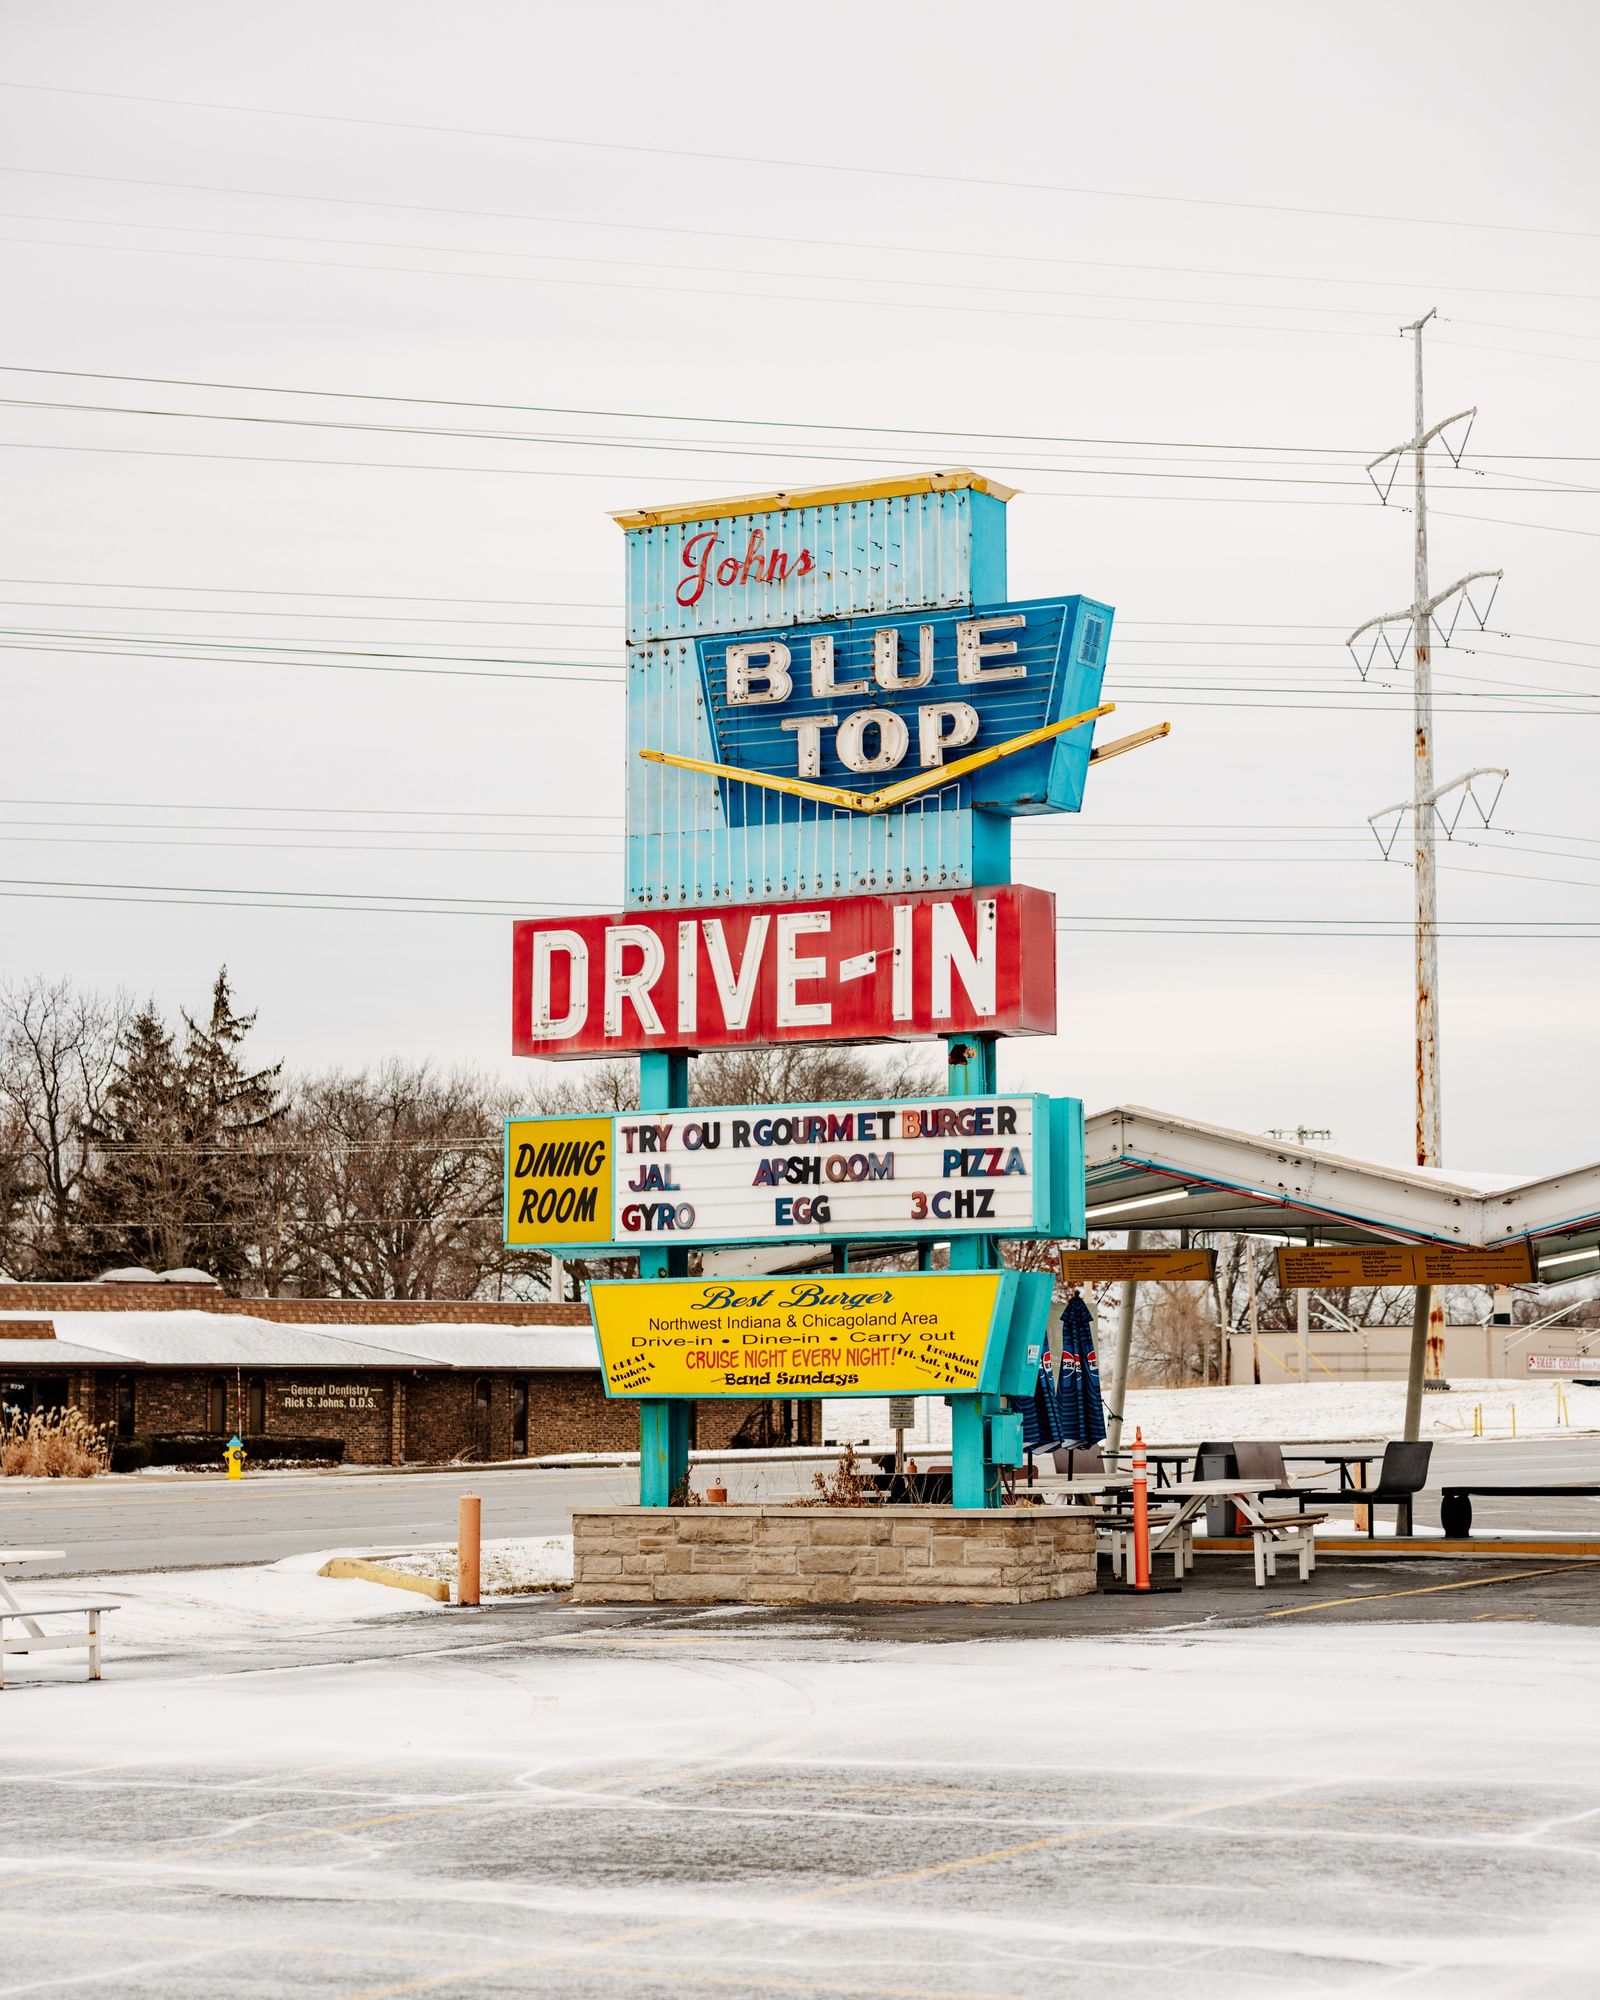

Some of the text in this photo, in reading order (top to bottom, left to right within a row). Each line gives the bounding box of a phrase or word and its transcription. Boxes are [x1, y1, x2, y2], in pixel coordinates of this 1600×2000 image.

[676, 529, 816, 607] Johns
[726, 614, 1027, 706] BLUE
[781, 701, 980, 778] TOP
[532, 899, 998, 1041] DRIVE-IN
[621, 1124, 673, 1154] TRY
[902, 1106, 1017, 1139] BURGER
[514, 1140, 606, 1178] DINING
[628, 1163, 681, 1192] JAL
[943, 1147, 1026, 1178] PIZZA
[518, 1187, 598, 1223] ROOM
[621, 1202, 696, 1231] GYRO
[775, 1195, 831, 1226] EGG
[690, 1283, 895, 1310] Best Burger
[649, 1312, 938, 1331] Northwest Indiana & Chicagoland Area
[631, 1330, 956, 1347] Drive-in Dine-in Carry out
[612, 1353, 646, 1371] GREAT
[686, 1347, 896, 1369] CRUISE NIGHT EVERY NIGHT!
[920, 1354, 940, 1367] Sat.
[954, 1365, 977, 1379] Sun.
[926, 1344, 979, 1367] Breakfast
[1537, 1357, 1556, 1368] SMART
[1559, 1357, 1581, 1369] CHOICE
[610, 1366, 647, 1383] Shakes
[623, 1376, 651, 1390] Malts
[724, 1371, 859, 1386] Band Sundays
[290, 1384, 369, 1397] General Dentistry
[284, 1397, 377, 1409] Rick S. Johns, D.D.S.
